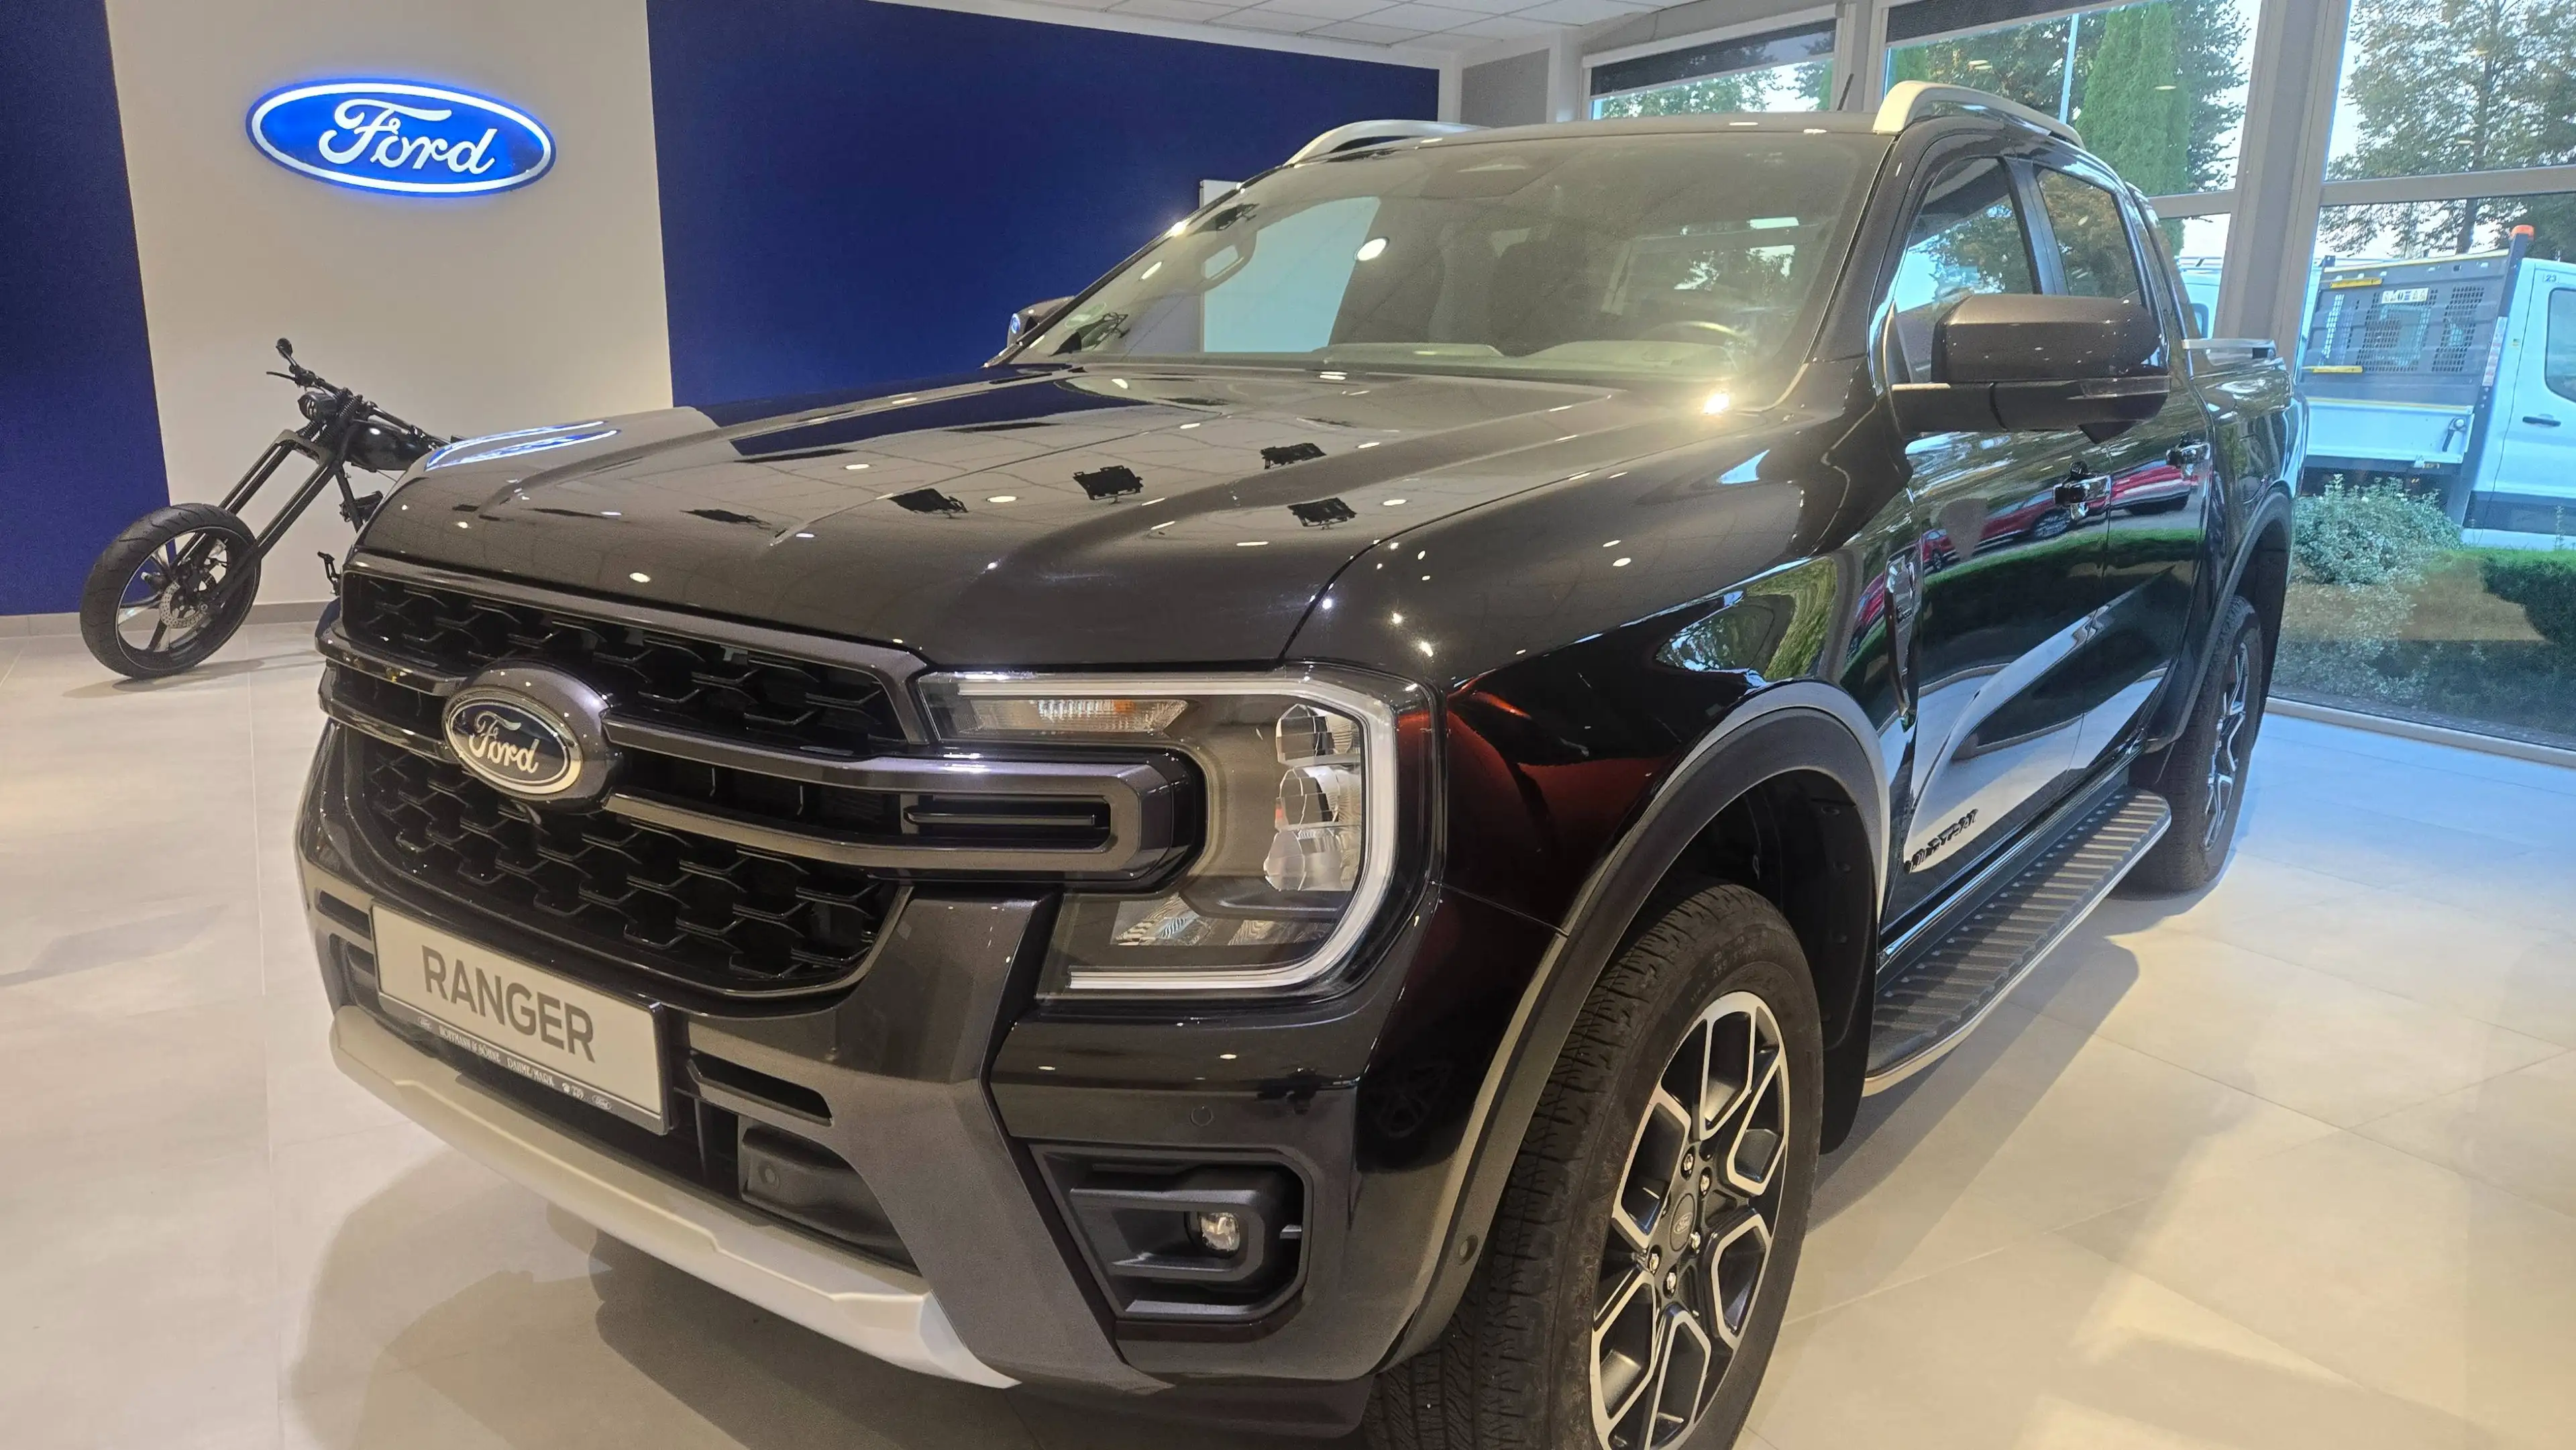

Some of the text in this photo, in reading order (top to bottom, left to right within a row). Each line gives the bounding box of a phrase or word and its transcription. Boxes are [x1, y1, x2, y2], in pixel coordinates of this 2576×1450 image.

[319, 99, 498, 174] Ford
[469, 711, 539, 774] Ford
[421, 945, 596, 1064] RANGER
